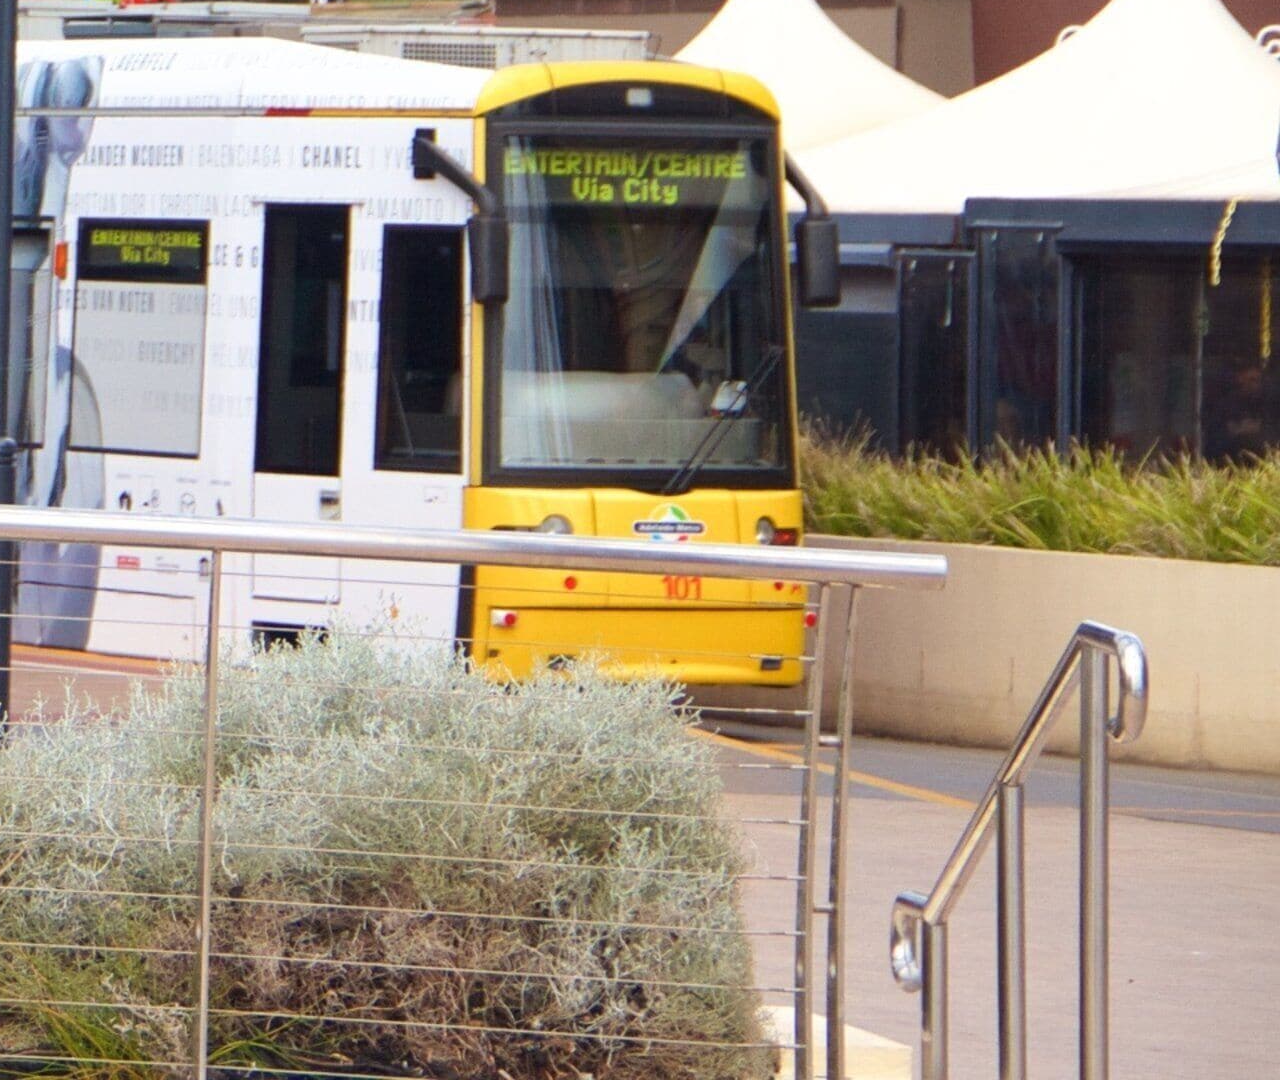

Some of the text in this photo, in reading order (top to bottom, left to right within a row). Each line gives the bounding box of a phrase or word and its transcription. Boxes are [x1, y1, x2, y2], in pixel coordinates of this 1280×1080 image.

[302, 144, 363, 169] CHANEL
[504, 148, 746, 178] ENTERTAIN/CENTRE
[572, 177, 679, 206] Via City
[121, 245, 171, 265] Via City
[662, 573, 702, 601] 101
